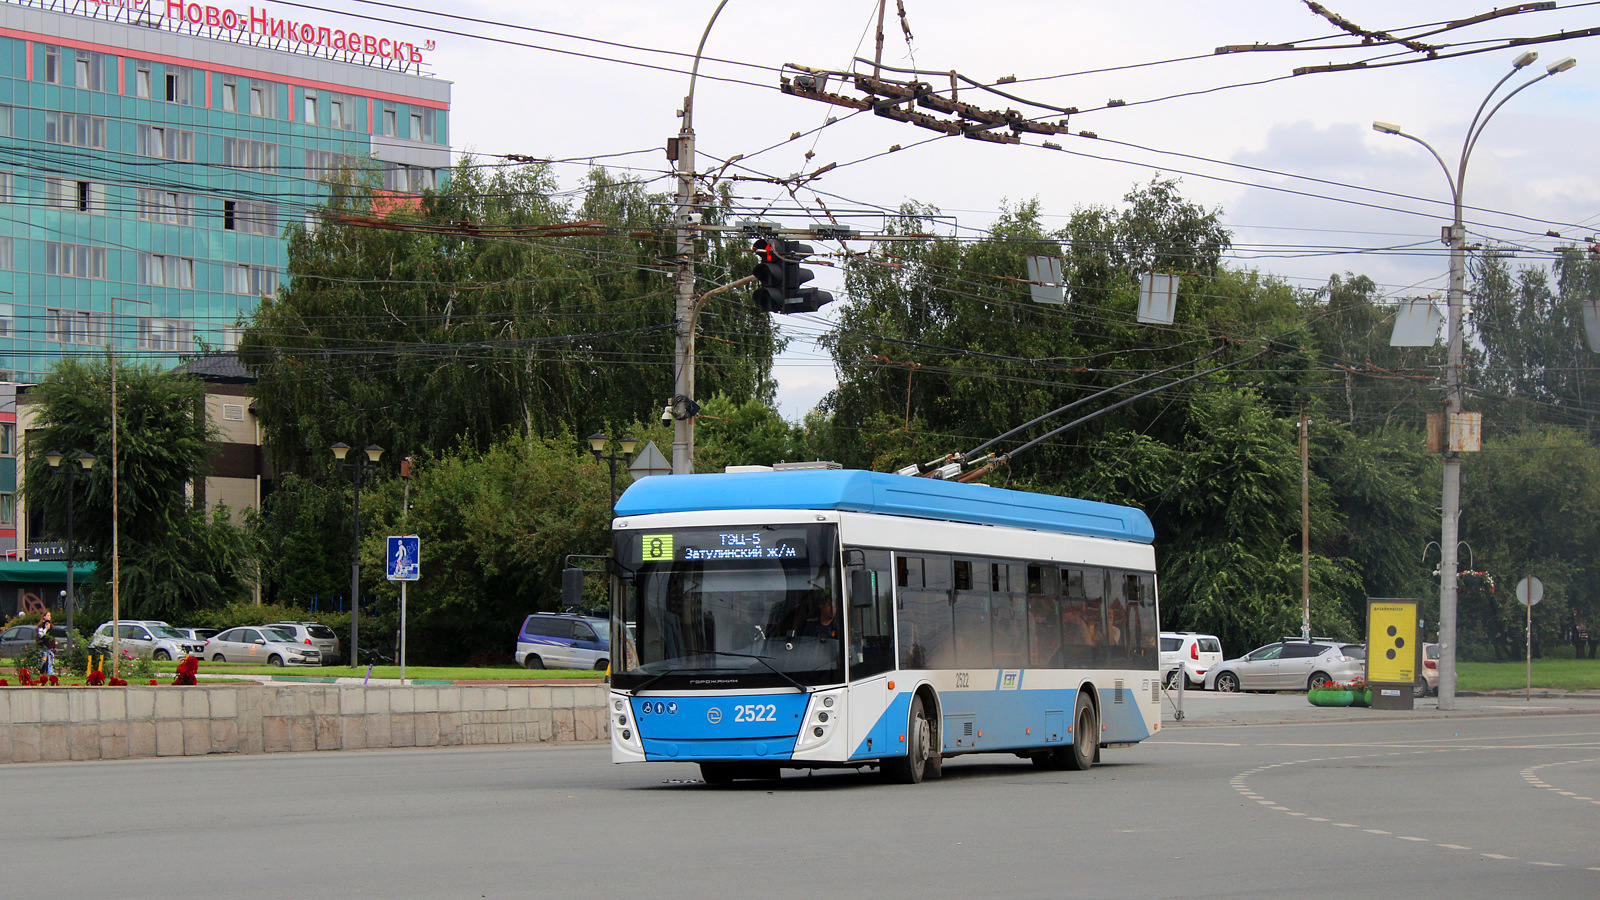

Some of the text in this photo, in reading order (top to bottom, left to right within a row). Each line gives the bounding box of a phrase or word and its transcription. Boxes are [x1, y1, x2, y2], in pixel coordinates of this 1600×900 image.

[719, 533, 761, 545] ТЭЦ-5
[34, 547, 65, 555] МЯТА
[650, 537, 664, 558] 8
[685, 544, 796, 560] Затулинский ж/м
[956, 673, 969, 688] 2522
[735, 704, 776, 722] 2522
